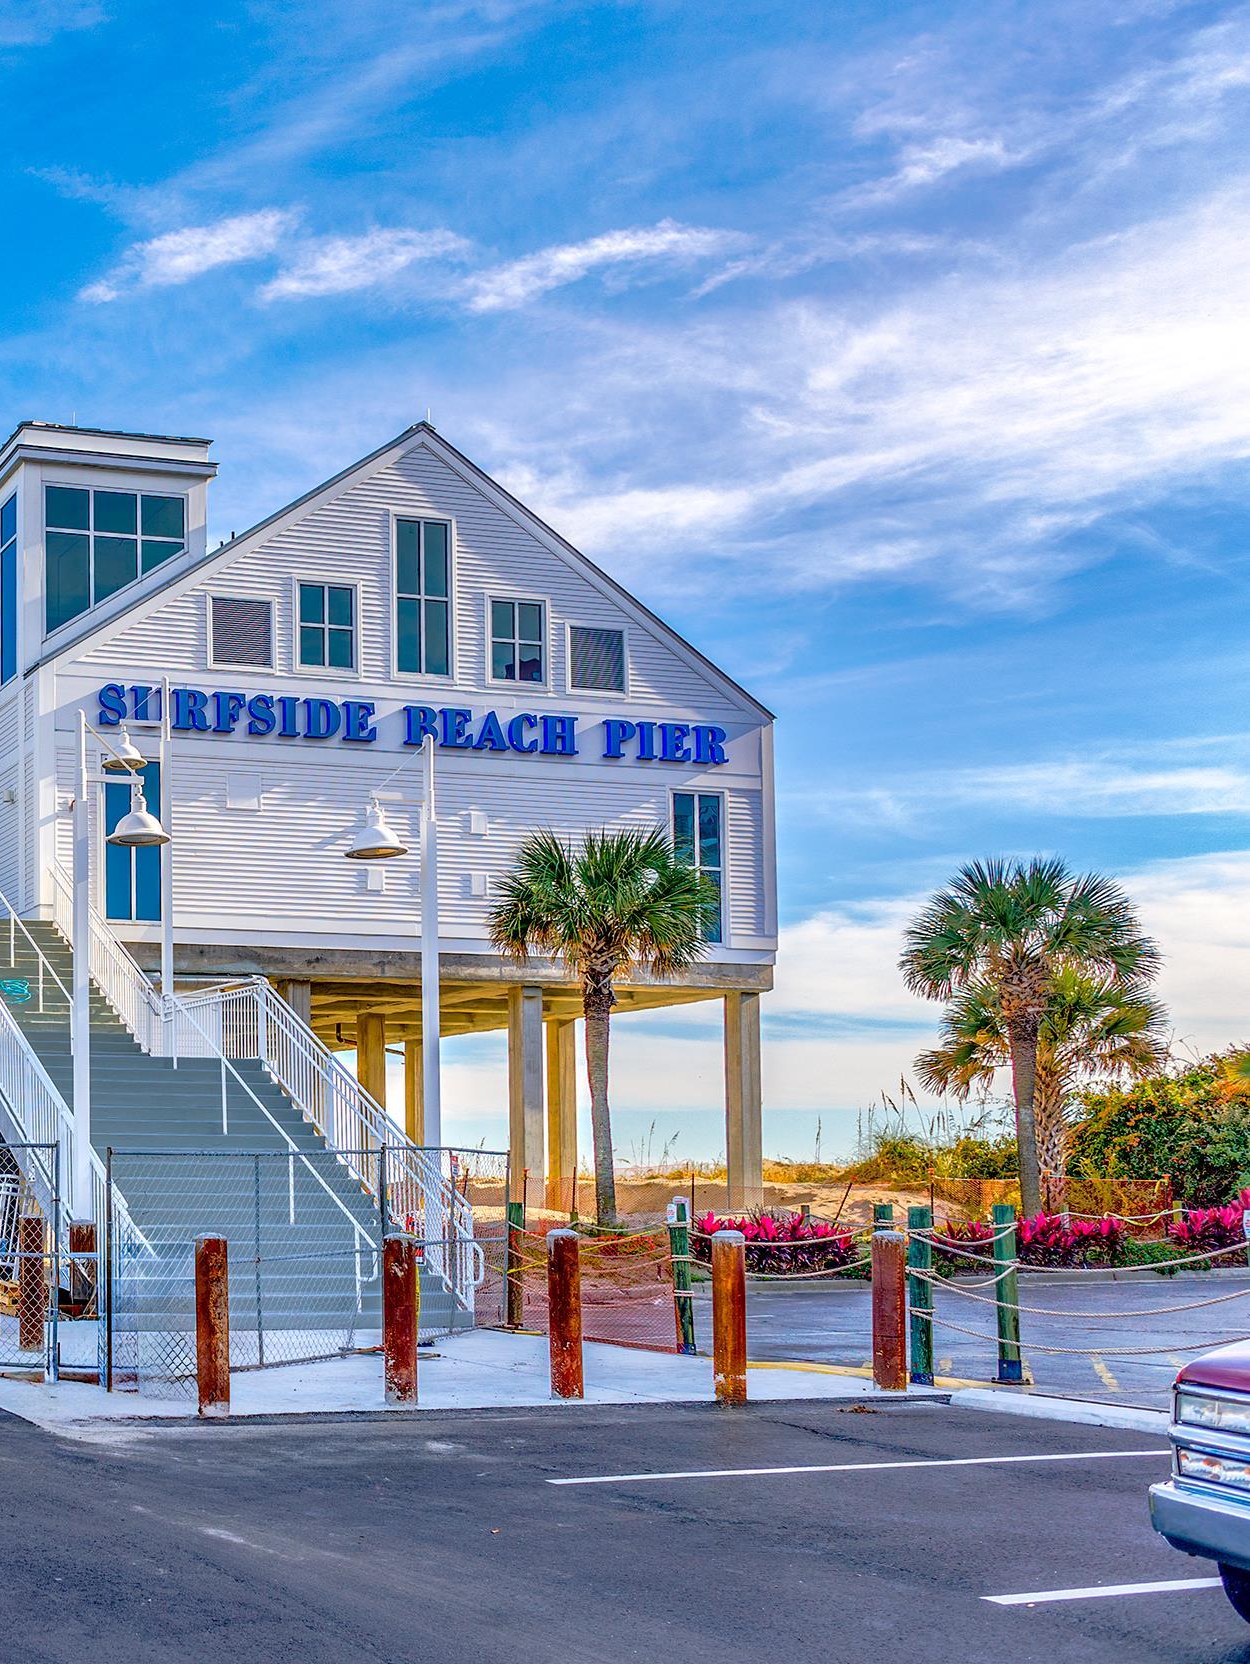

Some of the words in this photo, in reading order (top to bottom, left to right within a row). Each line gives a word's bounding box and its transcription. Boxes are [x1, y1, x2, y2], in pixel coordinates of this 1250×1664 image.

[99, 683, 377, 742] SURFSIDE
[403, 705, 579, 756] BEACH
[602, 719, 729, 765] PIER
